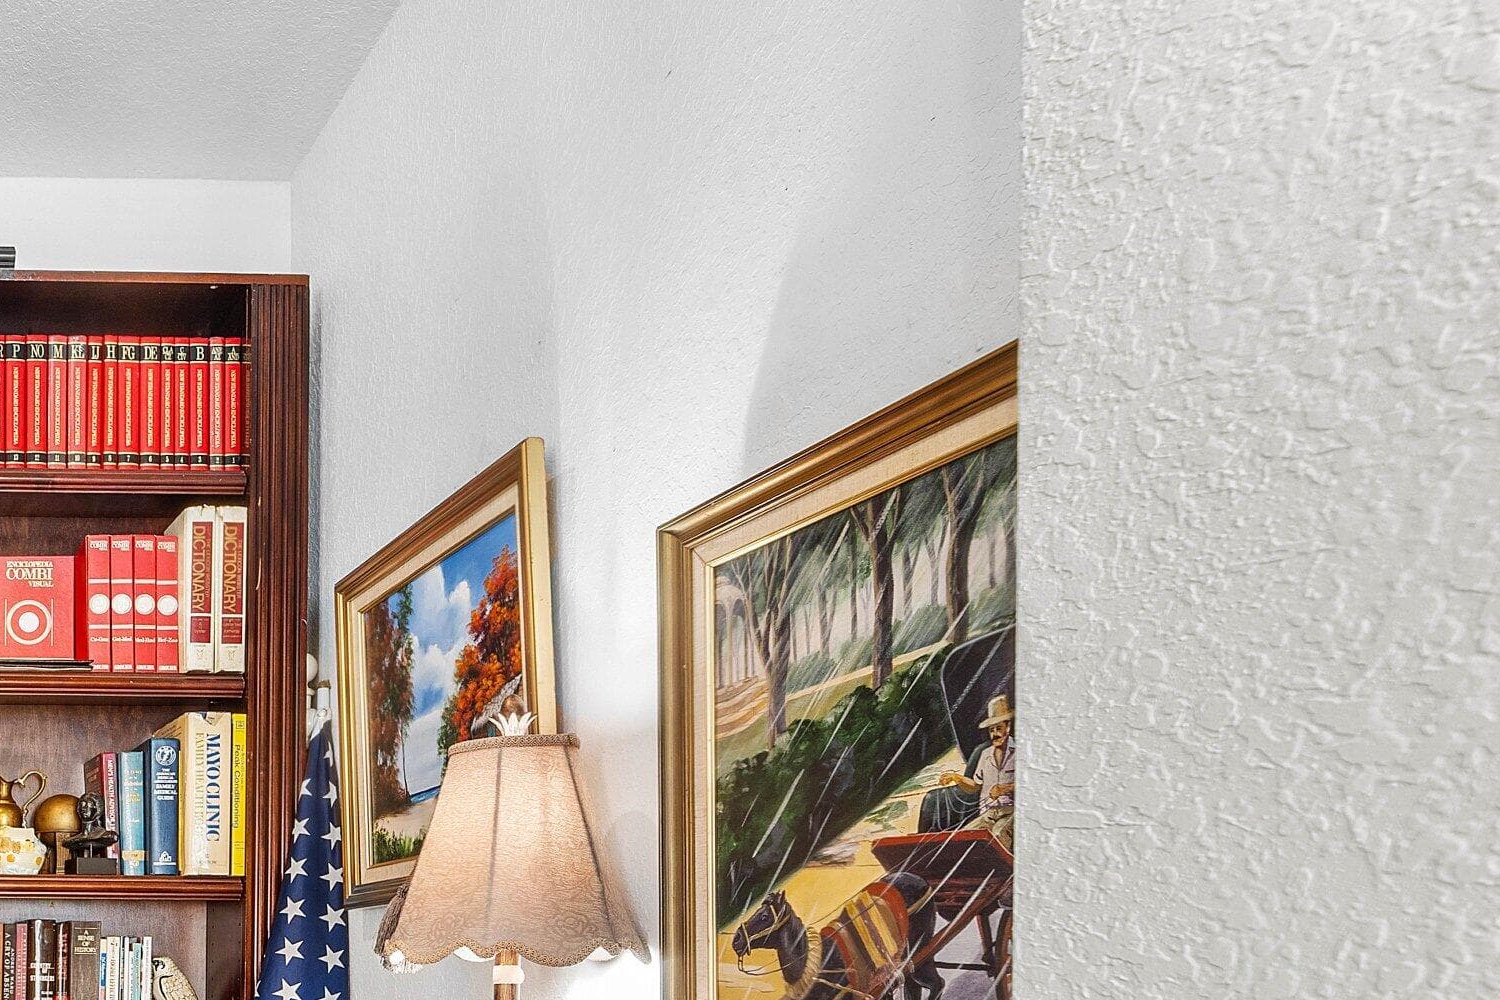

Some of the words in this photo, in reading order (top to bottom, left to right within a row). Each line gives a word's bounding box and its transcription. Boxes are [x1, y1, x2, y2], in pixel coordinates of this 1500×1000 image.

[12, 345, 20, 358] P
[31, 345, 44, 358] NO
[54, 347, 63, 358] M
[107, 347, 115, 358] H
[122, 347, 135, 359] FG
[144, 347, 157, 359] DE
[196, 347, 204, 360] B
[5, 567, 54, 580] COMBI
[192, 525, 205, 611] DICTIONARY
[224, 525, 237, 612] DICTIONARY
[196, 732, 204, 768] FAMILY
[206, 733, 220, 780] MAYO
[195, 770, 204, 809] HEALTH
[206, 782, 220, 842] CLINIC
[3, 959, 10, 969] OF
